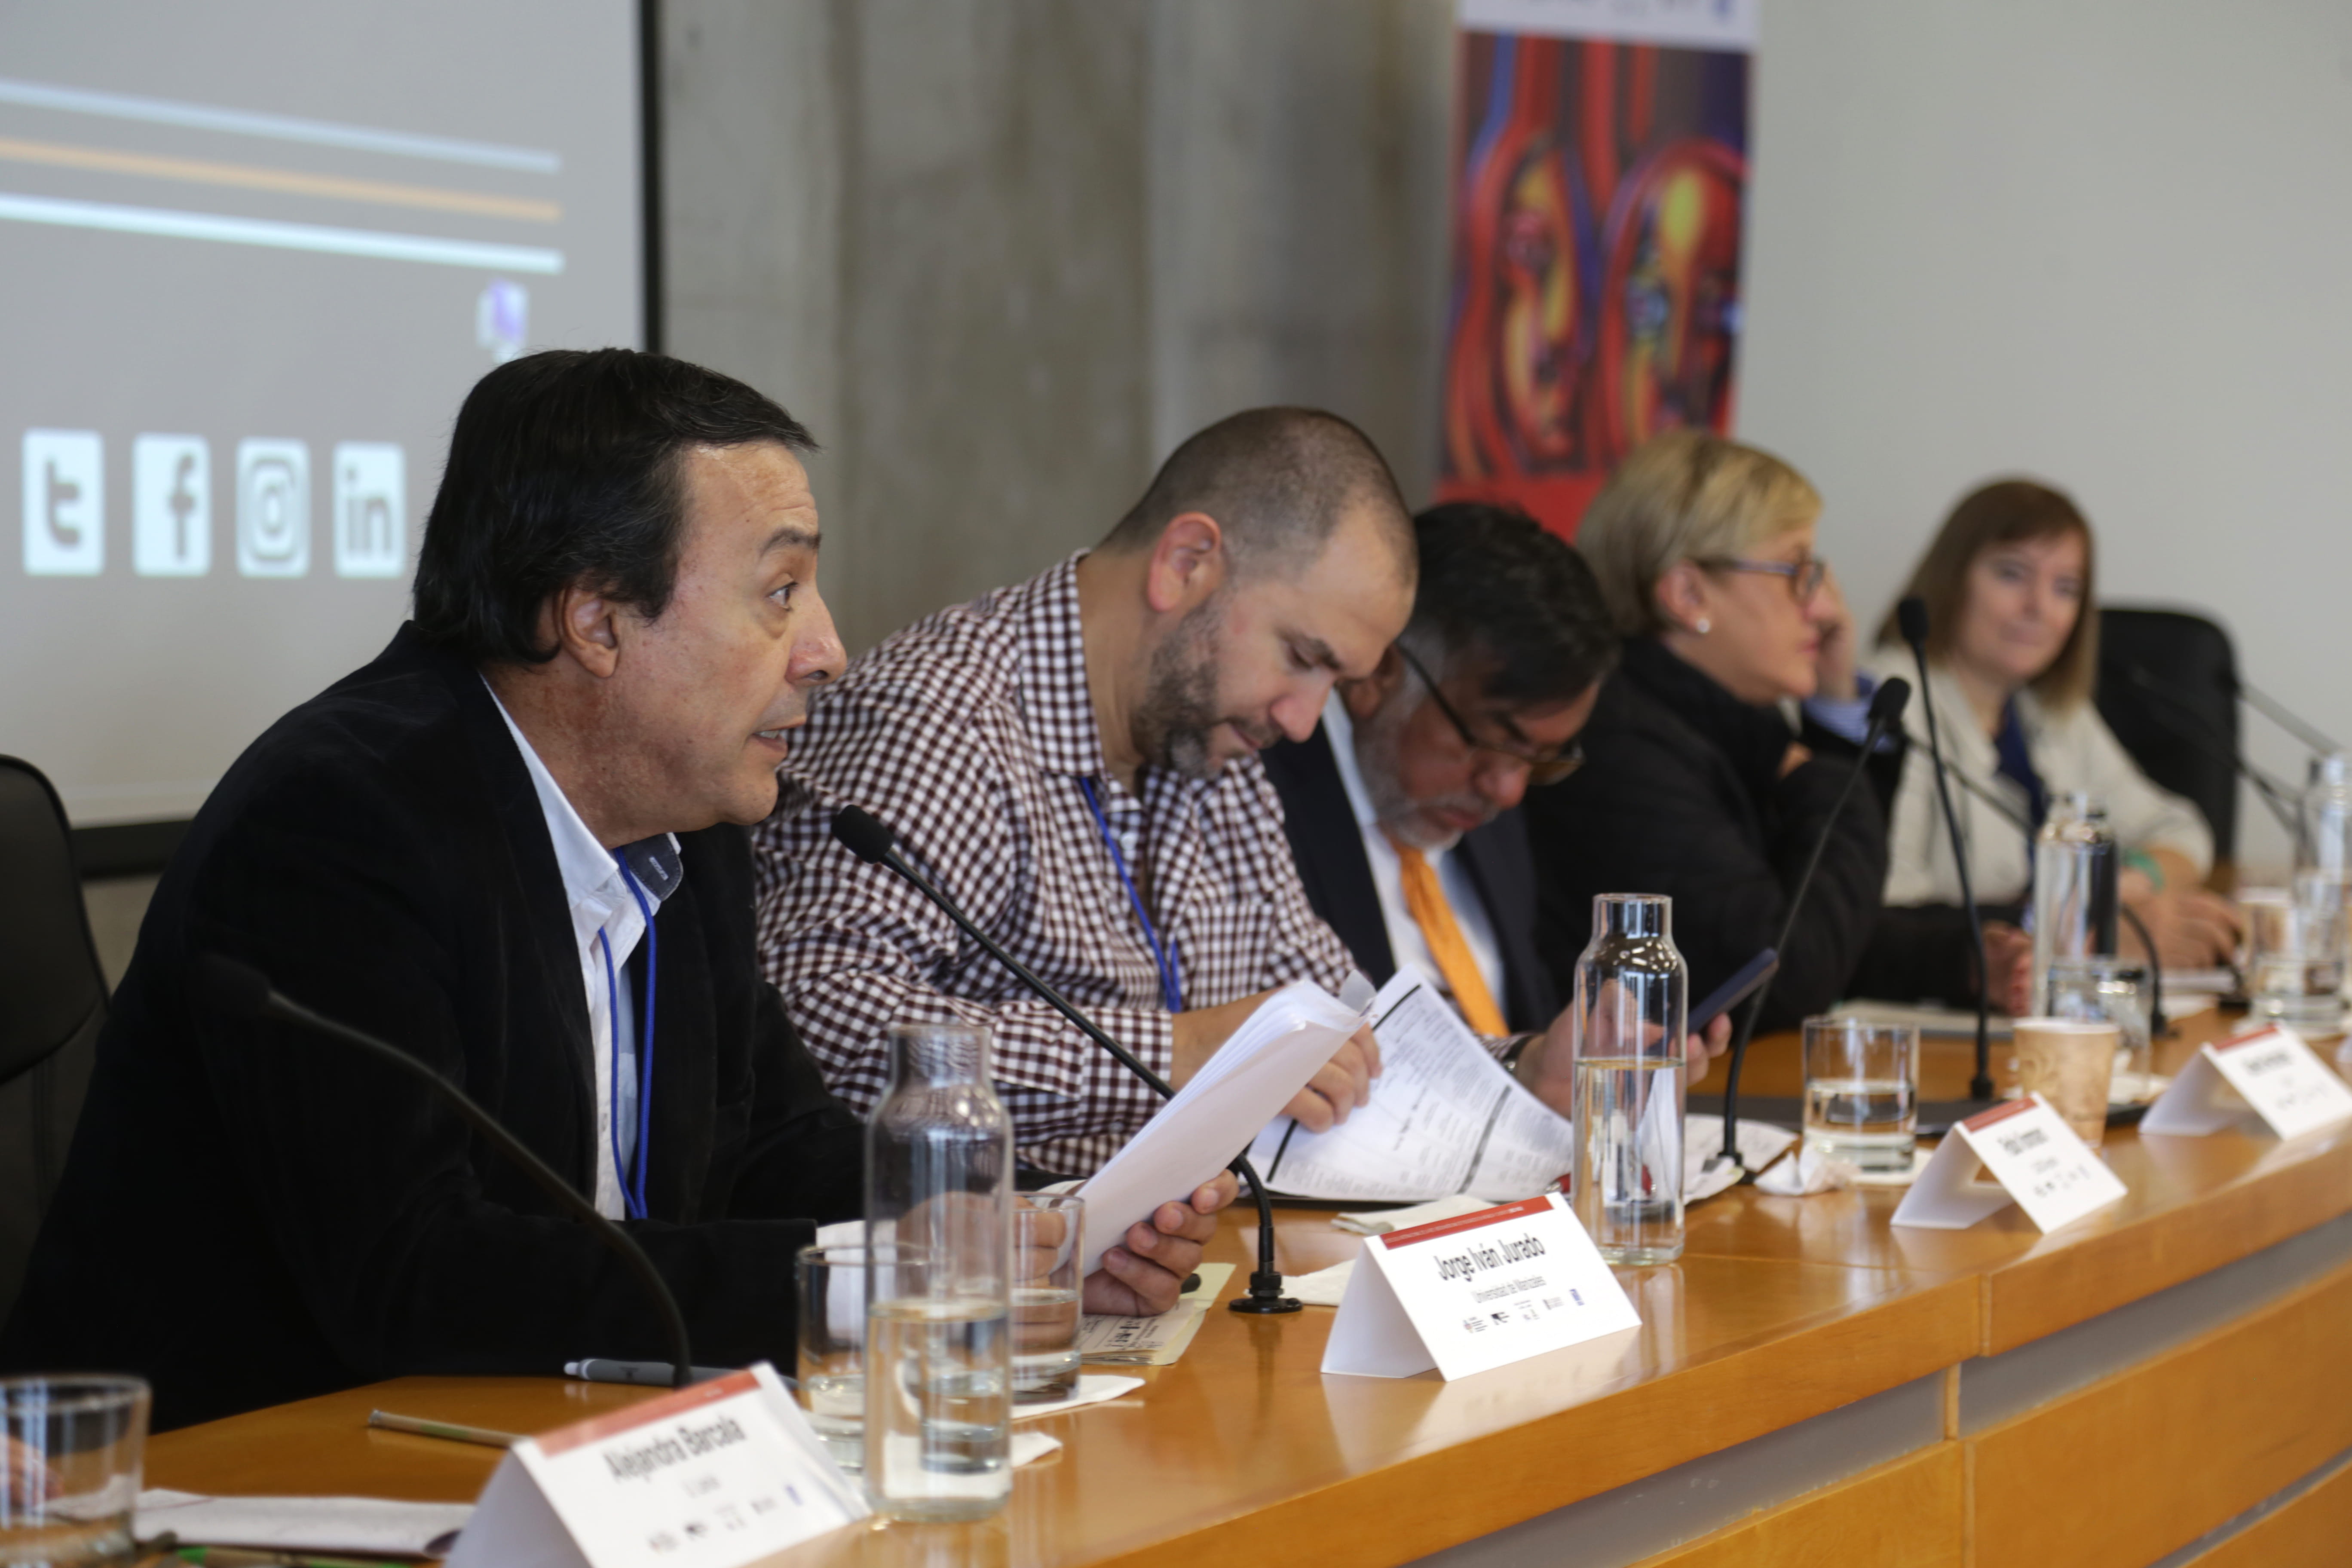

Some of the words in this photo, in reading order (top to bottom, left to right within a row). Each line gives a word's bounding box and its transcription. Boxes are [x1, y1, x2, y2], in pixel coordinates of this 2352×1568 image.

[345, 464, 392, 559] in
[1433, 1255, 1475, 1282] Jorge
[1467, 1243, 1504, 1271] Iván
[1498, 1232, 1545, 1264] Jurado
[603, 1436, 688, 1483] Alejandra
